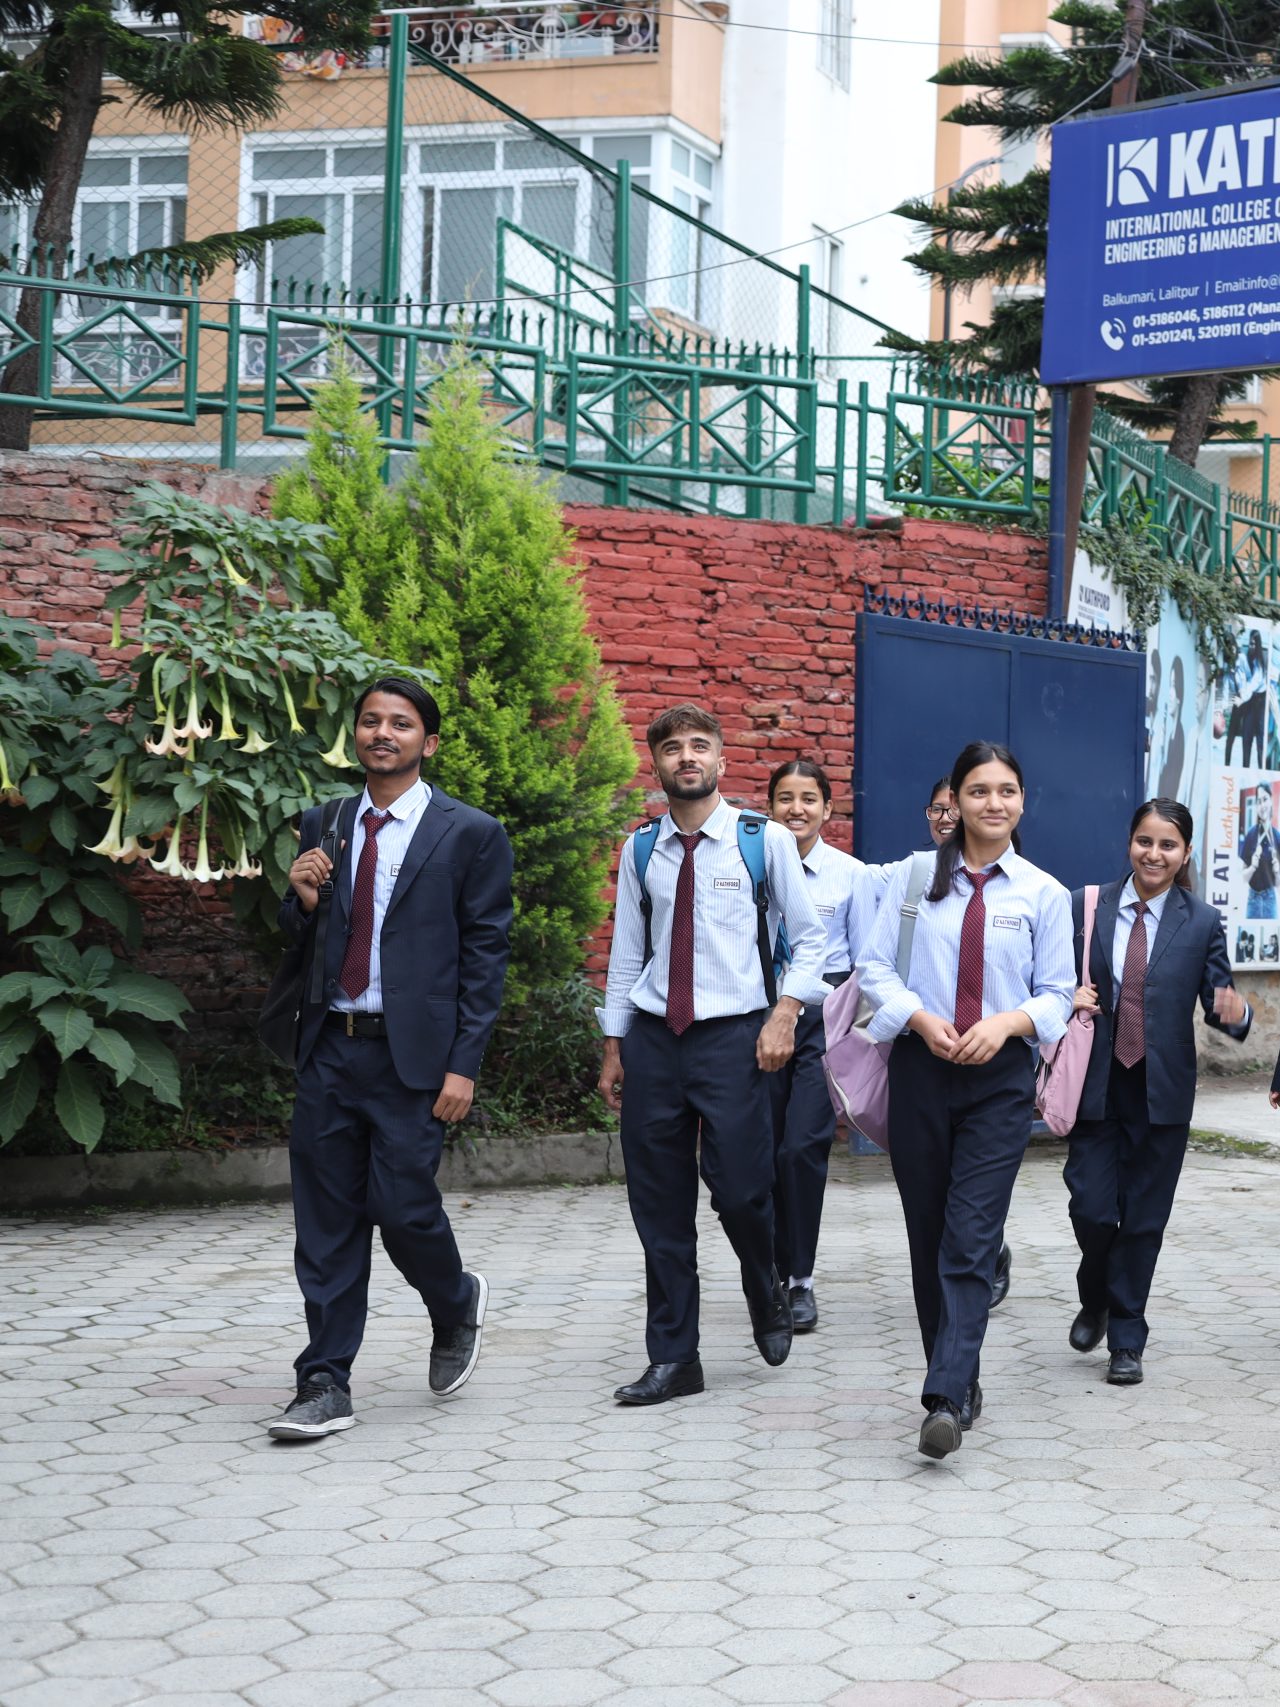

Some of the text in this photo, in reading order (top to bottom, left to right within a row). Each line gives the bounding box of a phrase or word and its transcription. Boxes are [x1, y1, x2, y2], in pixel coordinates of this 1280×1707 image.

[1105, 207, 1208, 240] INTERNATIONAL
[1212, 198, 1272, 226] COLLEGE
[1104, 234, 1186, 265] ENGINEERING
[1188, 233, 1198, 254] &
[1102, 289, 1156, 307] Balkumari,
[1159, 285, 1200, 300] Lalitpur
[1132, 308, 1200, 328] 01-5186046,
[1202, 303, 1245, 320] 5186112
[1131, 328, 1196, 347] 01-5201241,
[1198, 322, 1241, 339] 5201911
[1219, 775, 1241, 848] kathford
[1212, 848, 1230, 882] AT
